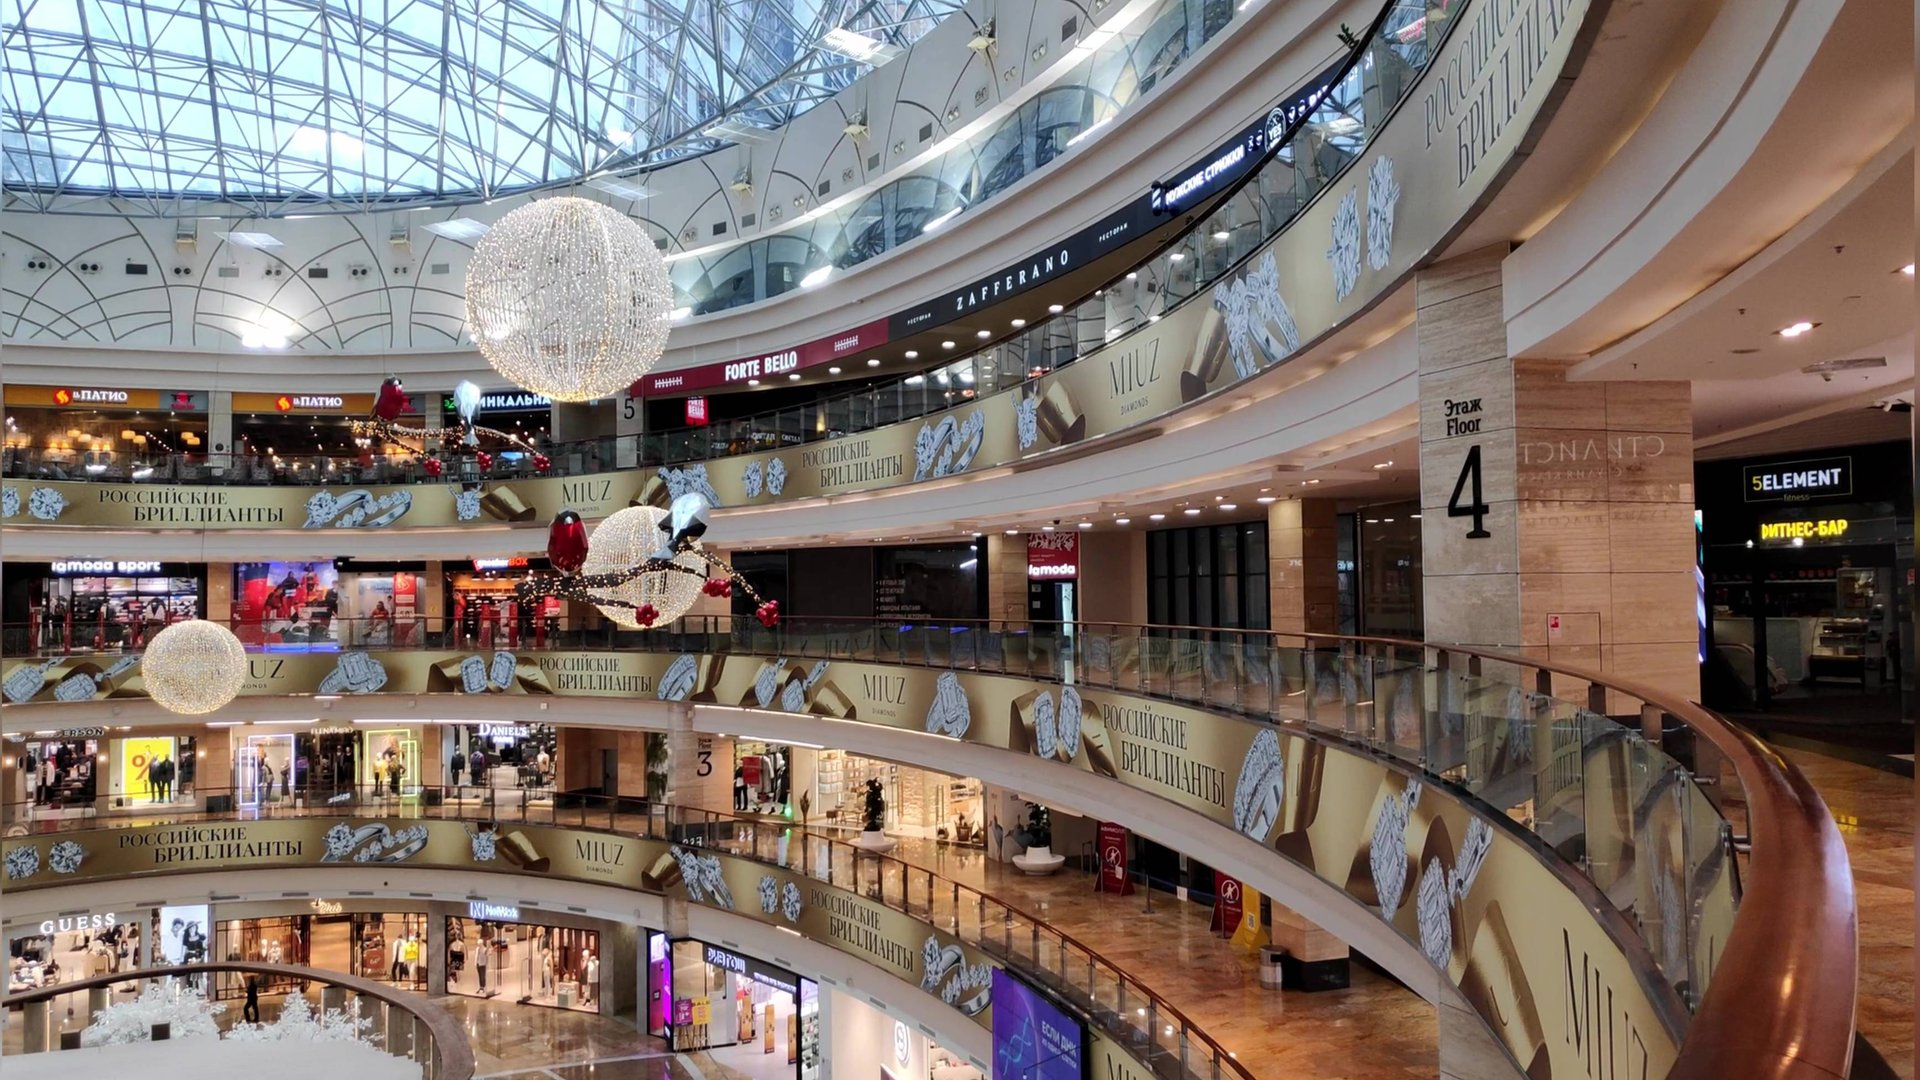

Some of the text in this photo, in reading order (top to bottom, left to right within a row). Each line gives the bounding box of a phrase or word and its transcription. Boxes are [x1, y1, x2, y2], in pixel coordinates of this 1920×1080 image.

[1425, 0, 1519, 149] РОССИЙС
[1457, 0, 1572, 187] БРИЛЛИА
[1205, 144, 1245, 181] СТРИЖКИ
[1099, 222, 1128, 242] РЕСТОРАН
[956, 250, 1069, 311] ZAFFERANO
[725, 351, 797, 381] FORTE BELLO
[1109, 337, 1161, 399] MIUZ
[81, 390, 128, 401] ПАТИО
[301, 396, 343, 406] ПАТИО
[480, 394, 552, 408] ИНКАЛЬНА
[1444, 398, 1482, 417] Этаж
[624, 398, 635, 420] 5
[1446, 417, 1481, 437] Floor
[802, 440, 871, 467] РОССИЙСКИЕ
[820, 454, 904, 488] БРИЛЛИАНТЫ
[1752, 468, 1842, 491] 5ELEMENT
[99, 488, 228, 505] РОССИЙСКИЕ
[562, 479, 612, 504] MIUZ
[1448, 445, 1491, 539] 4
[134, 507, 284, 522] БРИЛЛИАНТЫ
[1028, 563, 1076, 576] lamoda
[250, 659, 284, 679] UZ
[540, 654, 620, 672] РОССИЙСКИЕ
[558, 673, 652, 693] БРИЛЛИАНТЫ
[863, 673, 906, 705] MIUZ
[1103, 703, 1187, 751] РОССИЙСКИЕ
[697, 751, 712, 777] 3
[1121, 740, 1226, 808] БРИЛЛИАНТЫ
[120, 827, 247, 848] РОССИЙСКИЕ
[155, 840, 303, 863] БРИЛЛИАНТЫ
[576, 838, 624, 866] MIUZ
[811, 889, 880, 931] РОССИЙСКИЕ
[40, 913, 116, 934] GUESS
[829, 916, 914, 972] БРИЛЛИАНТЫ
